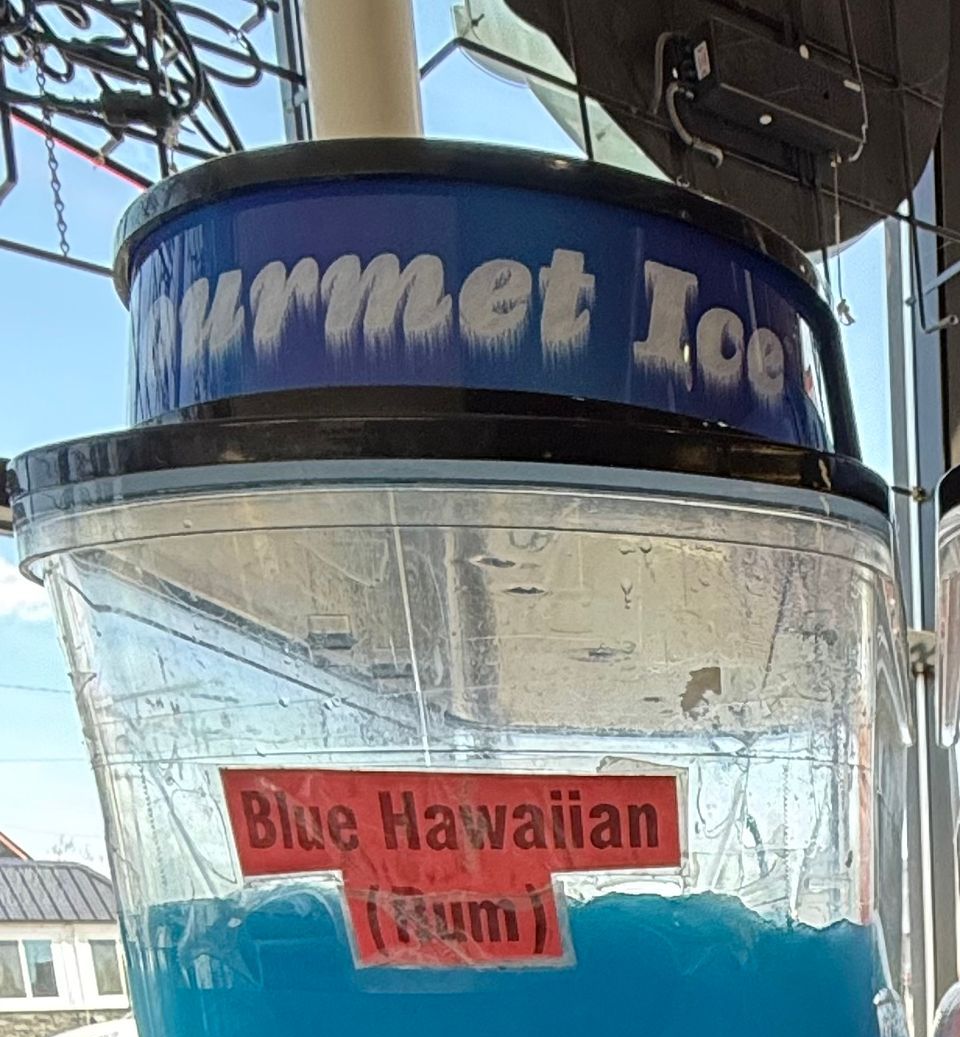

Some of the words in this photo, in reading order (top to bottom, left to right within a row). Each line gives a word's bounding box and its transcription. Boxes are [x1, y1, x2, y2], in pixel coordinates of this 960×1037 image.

[633, 260, 785, 402] Ice
[241, 789, 359, 851] Blue
[379, 789, 659, 851] Hawaiian
[366, 883, 549, 955] (Rum)
